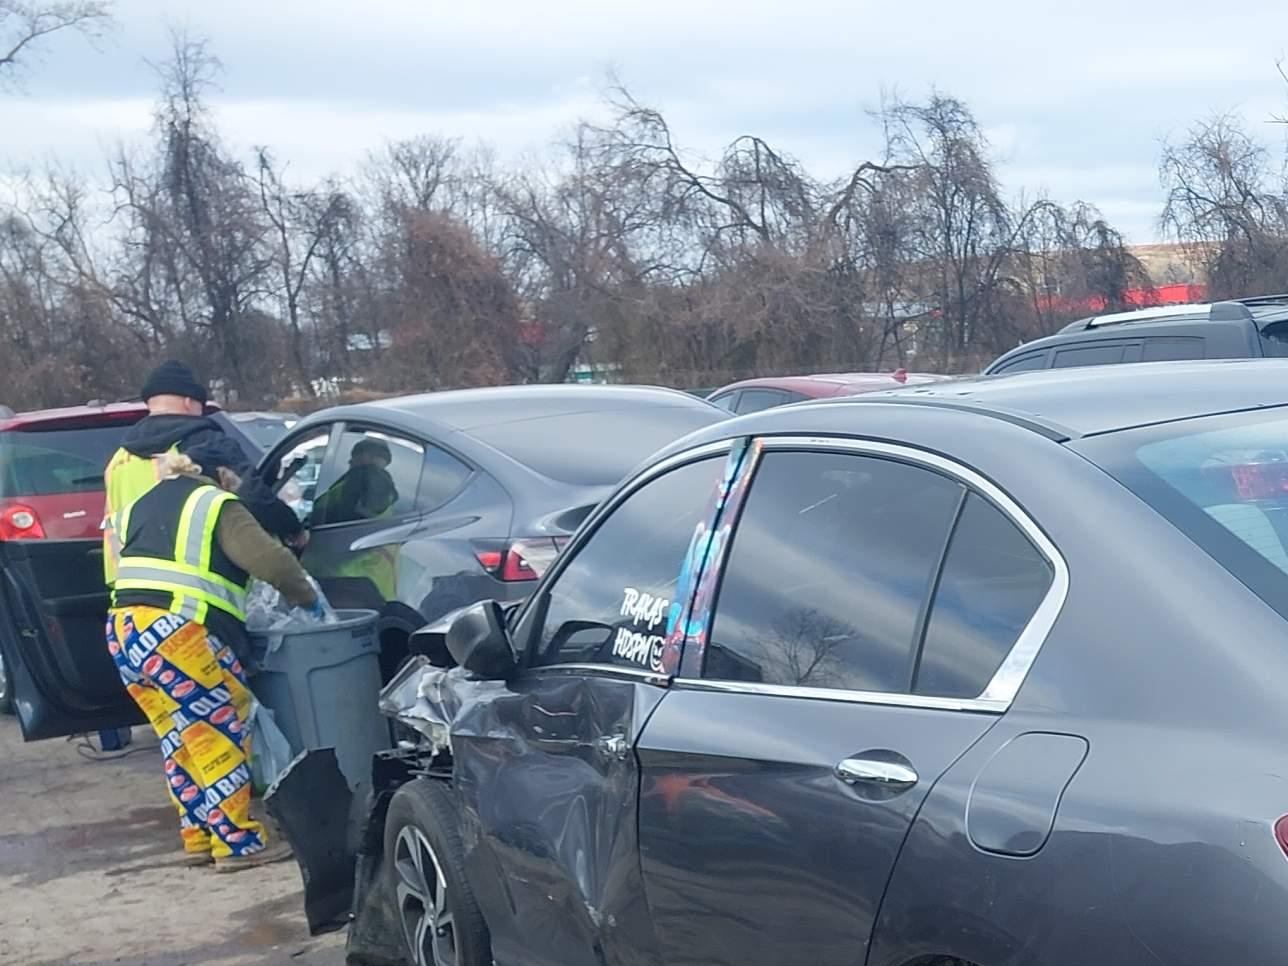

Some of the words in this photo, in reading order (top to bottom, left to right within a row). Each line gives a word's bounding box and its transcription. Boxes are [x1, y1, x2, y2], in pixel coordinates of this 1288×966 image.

[128, 630, 159, 668] OLD
[152, 613, 186, 639] BA
[188, 687, 232, 716] OLD
